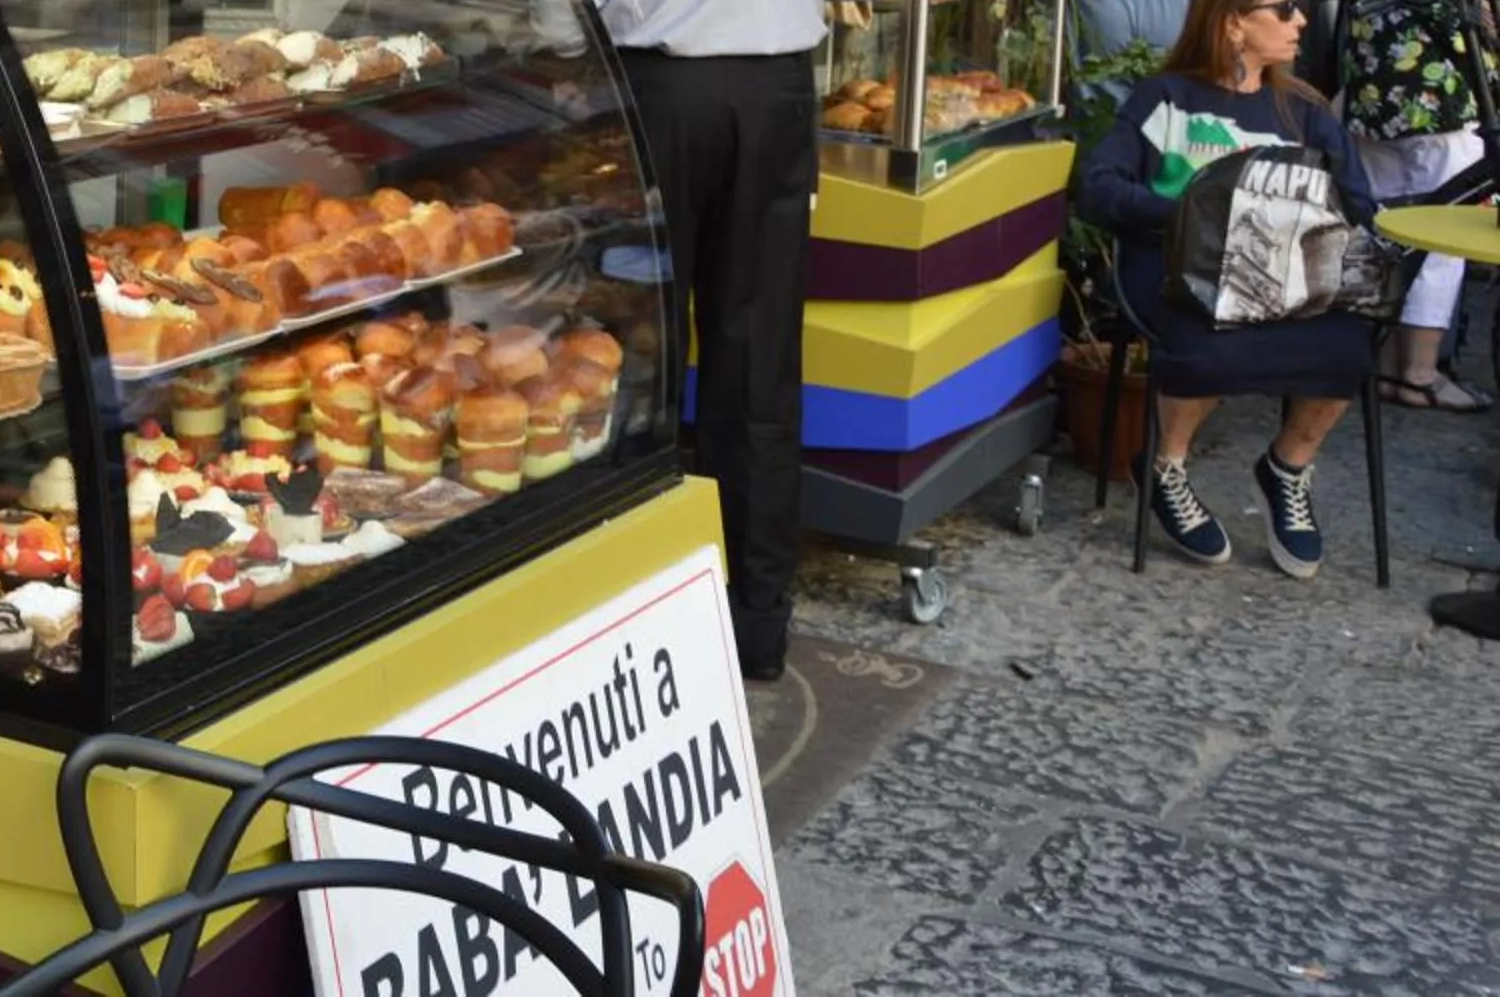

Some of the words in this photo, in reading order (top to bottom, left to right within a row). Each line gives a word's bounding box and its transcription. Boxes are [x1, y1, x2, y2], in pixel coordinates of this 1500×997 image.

[402, 641, 646, 871] Benvenuti
[652, 647, 680, 718] a
[704, 905, 767, 997] STOP
